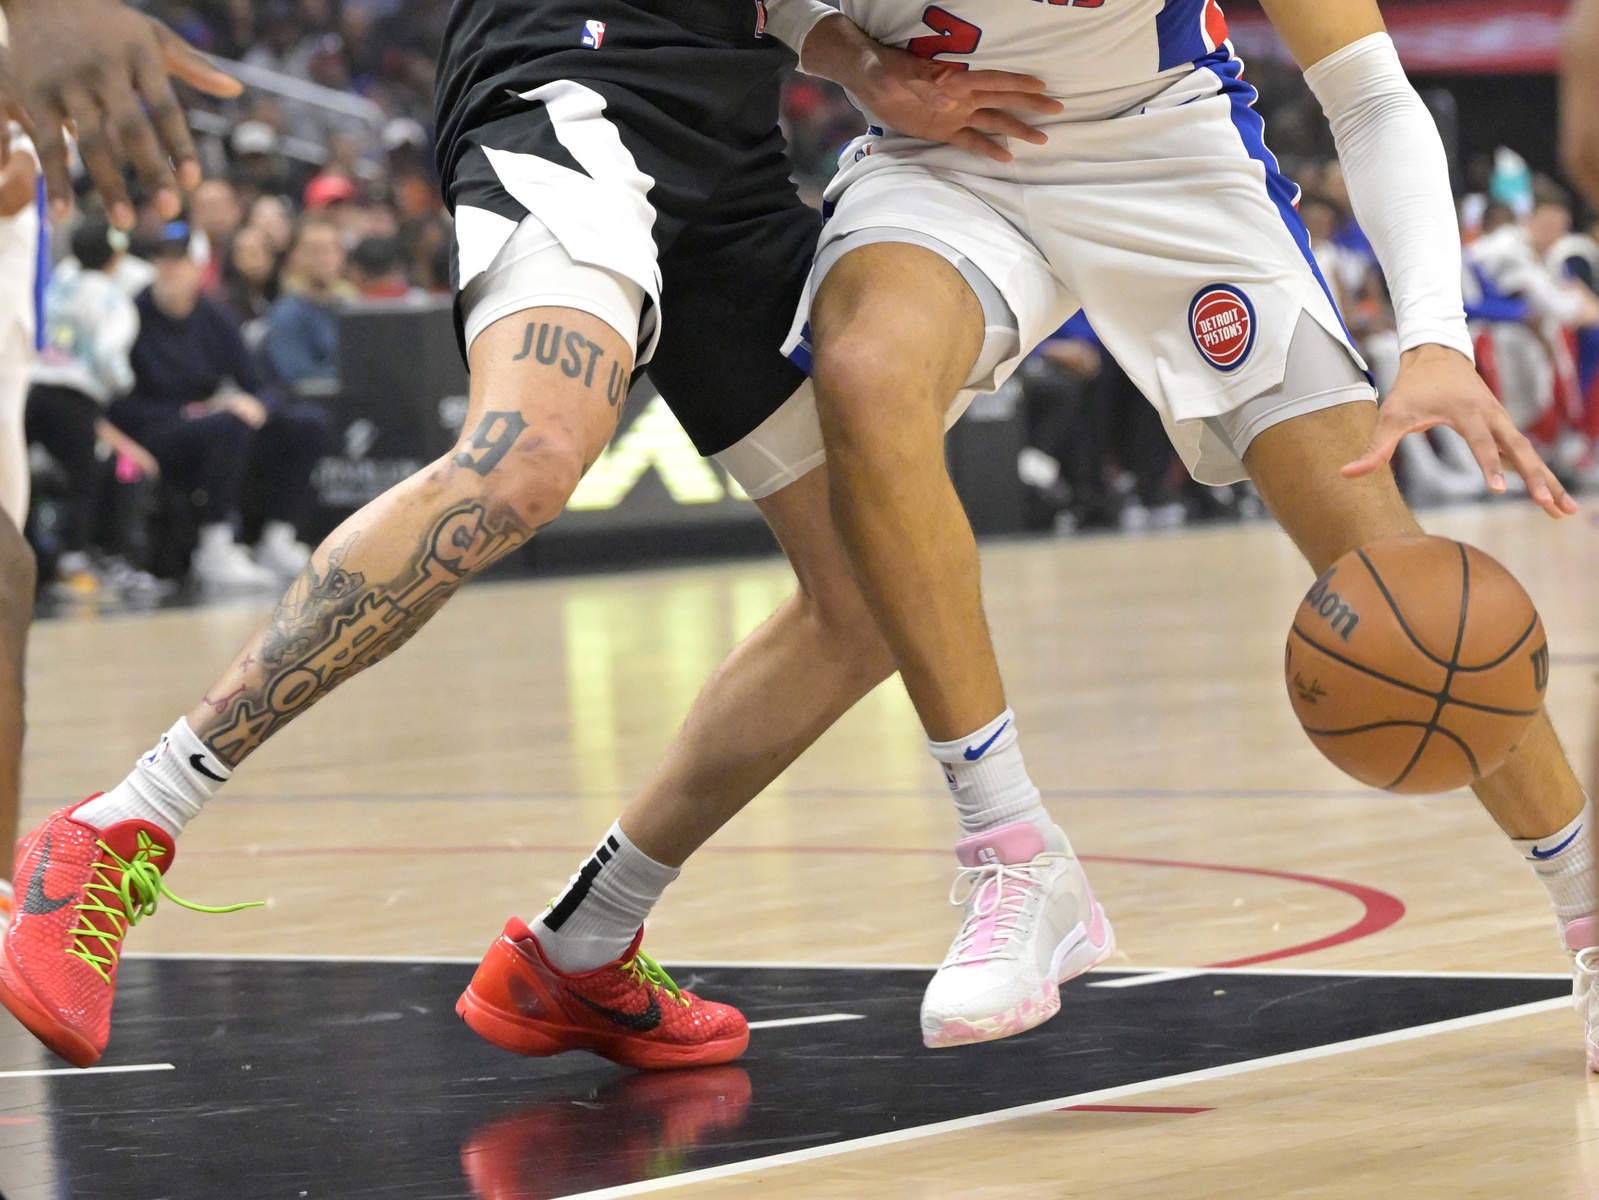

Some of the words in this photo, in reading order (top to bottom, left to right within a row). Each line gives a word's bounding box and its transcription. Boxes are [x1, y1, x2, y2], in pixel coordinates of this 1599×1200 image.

[907, 4, 982, 71] 2
[1199, 307, 1239, 333] DETROIT
[1202, 321, 1243, 348] PISTONS
[512, 322, 605, 389] JUST
[452, 409, 530, 477] 9
